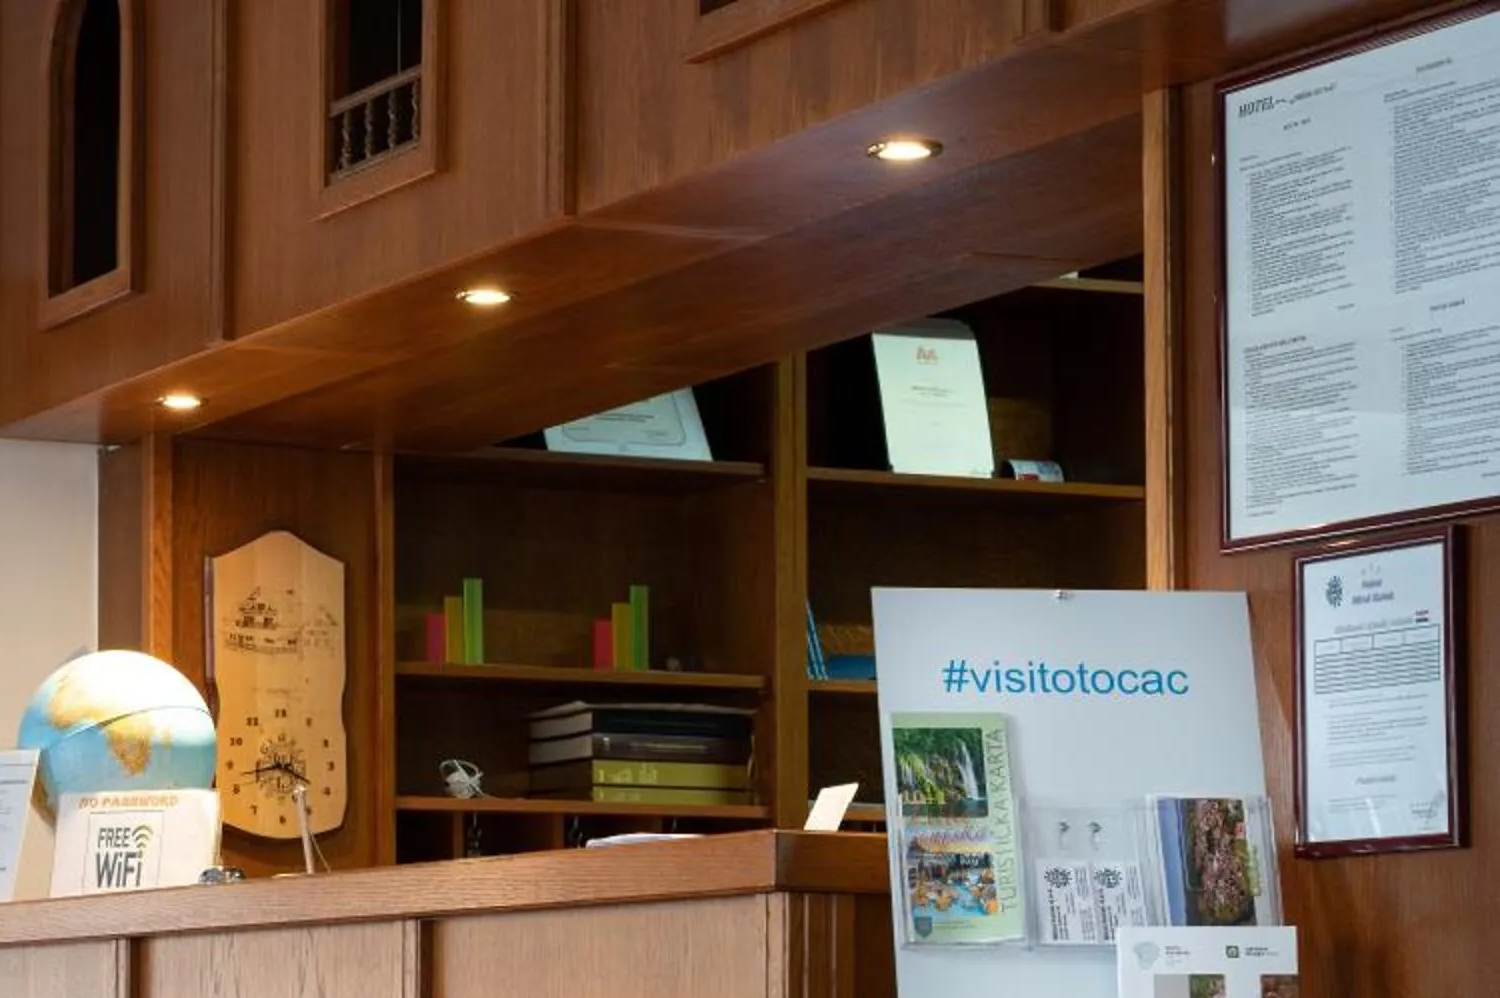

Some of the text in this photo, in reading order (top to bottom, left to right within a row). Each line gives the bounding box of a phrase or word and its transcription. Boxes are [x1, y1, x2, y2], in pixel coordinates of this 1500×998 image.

[942, 659, 1189, 695] #visitotocac
[985, 728, 1010, 794] KARTA
[79, 798, 99, 809] NO
[98, 827, 131, 848] FREE
[96, 850, 143, 888] WiFi
